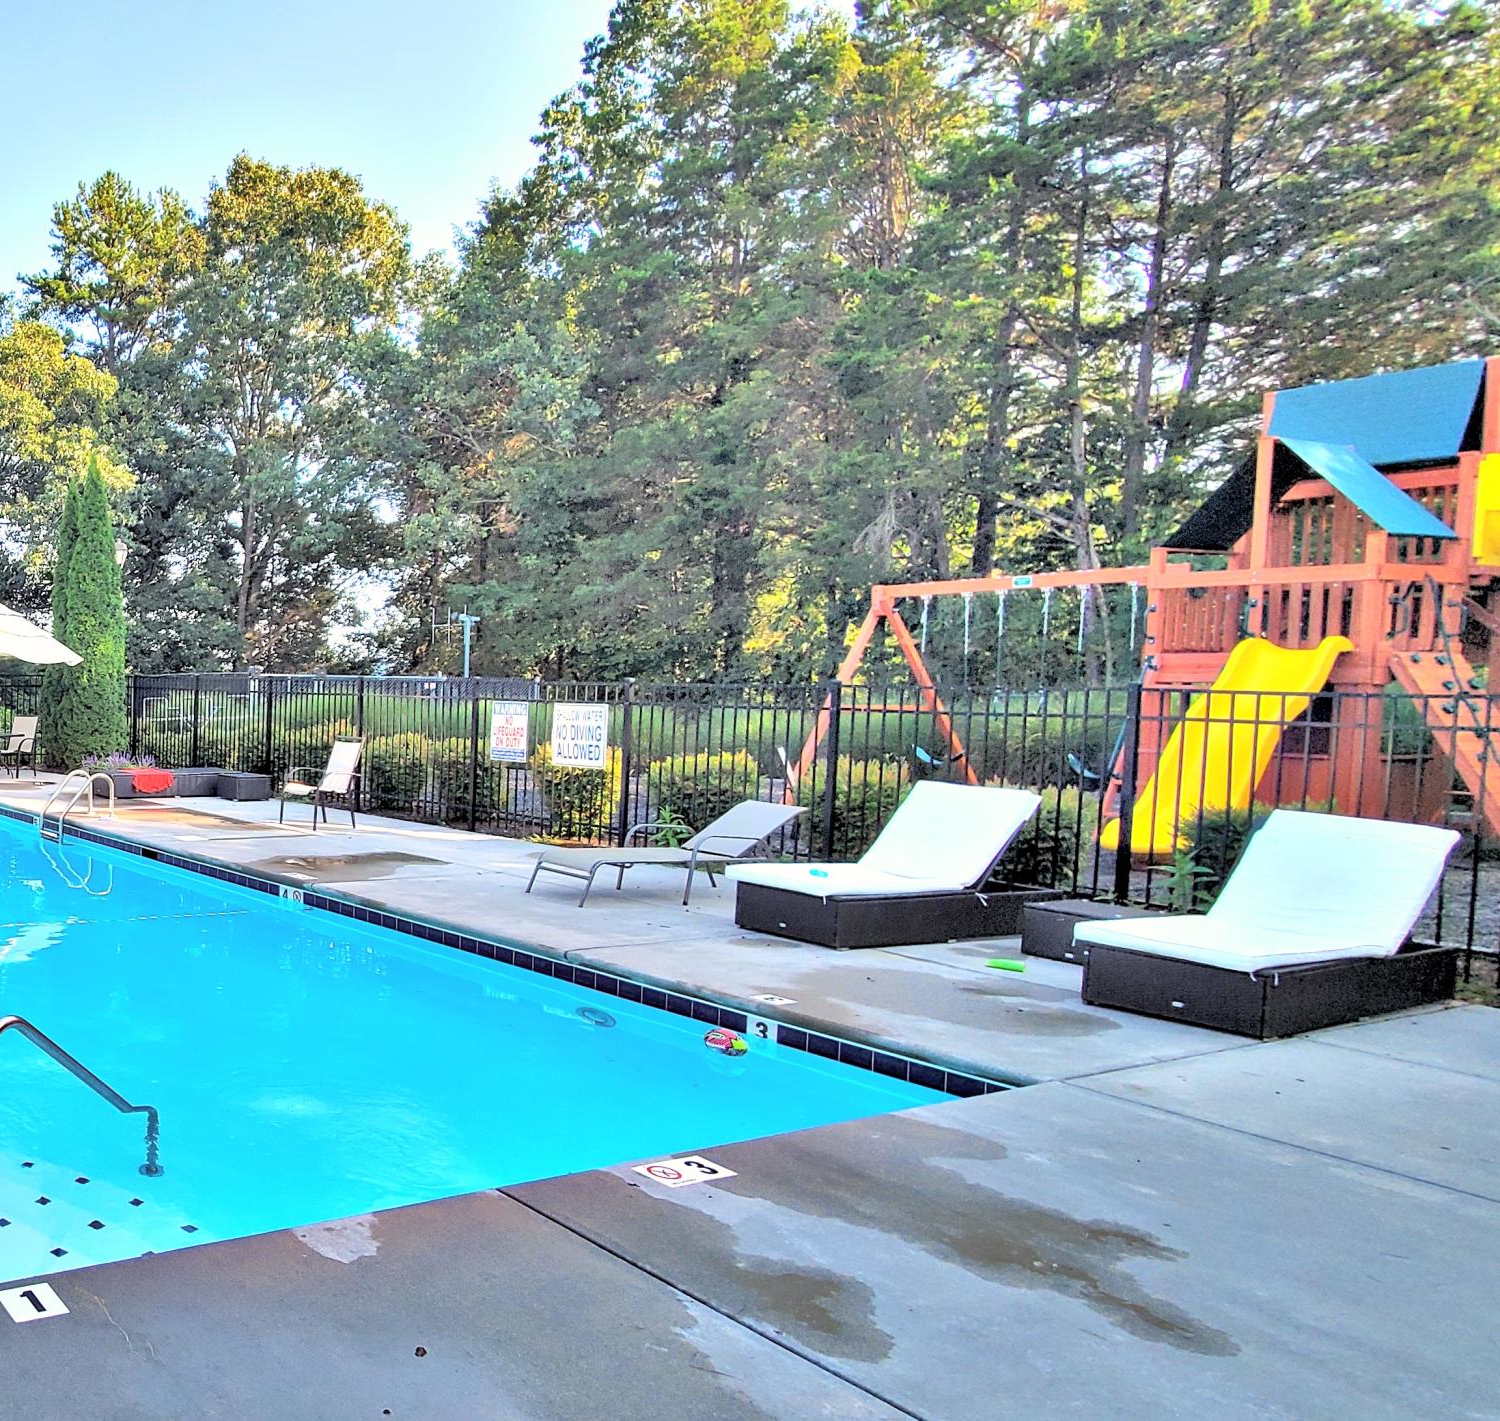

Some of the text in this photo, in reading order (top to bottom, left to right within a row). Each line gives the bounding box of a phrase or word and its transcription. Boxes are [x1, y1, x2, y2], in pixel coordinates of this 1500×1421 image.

[494, 703, 526, 715] WARNING
[505, 716, 513, 726] NO
[493, 725, 524, 738] LIFEGUARD
[556, 724, 602, 742] NO DIVING
[496, 737, 521, 748] ON DUTY
[557, 743, 601, 761] ALLOWED
[755, 1021, 768, 1039] 3
[684, 1160, 719, 1174] 3
[19, 1289, 48, 1313] 1
